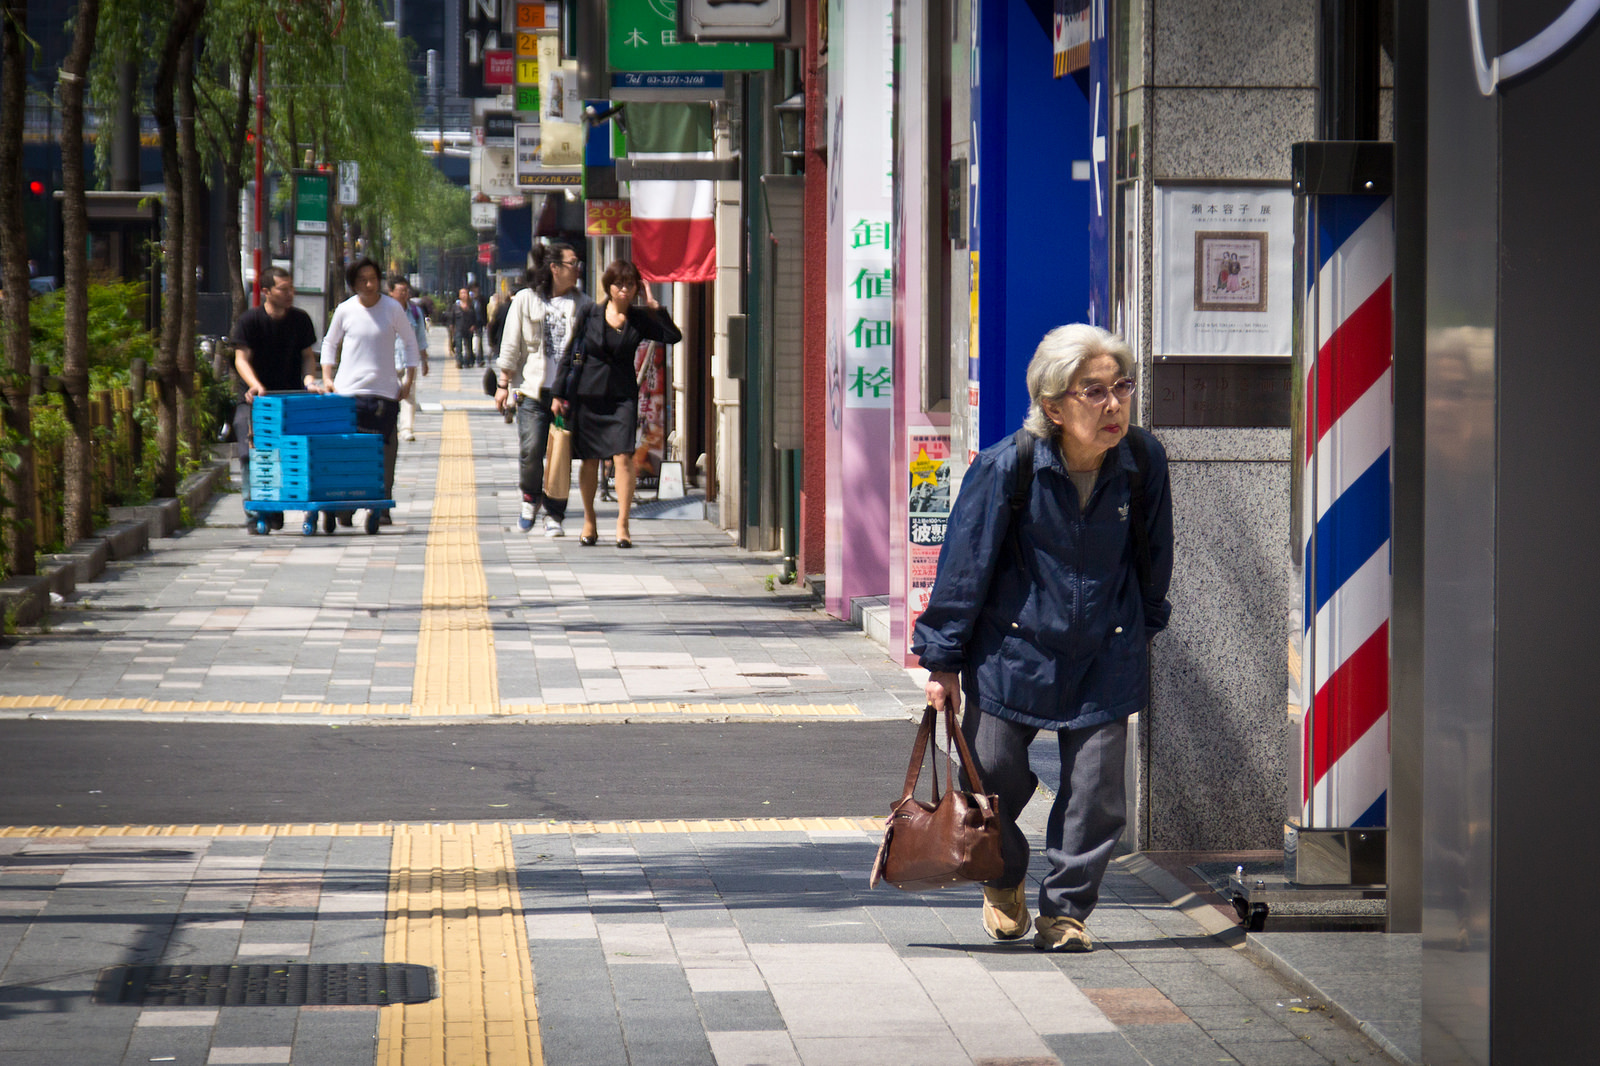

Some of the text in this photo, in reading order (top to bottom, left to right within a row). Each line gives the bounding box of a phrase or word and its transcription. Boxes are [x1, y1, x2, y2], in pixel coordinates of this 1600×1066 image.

[520, 7, 540, 22] 3F
[520, 35, 538, 50] 2F
[521, 63, 539, 78] 1F
[625, 74, 643, 84] Tel
[1260, 204, 1272, 215] 展
[848, 217, 892, 399] 卸値価格
